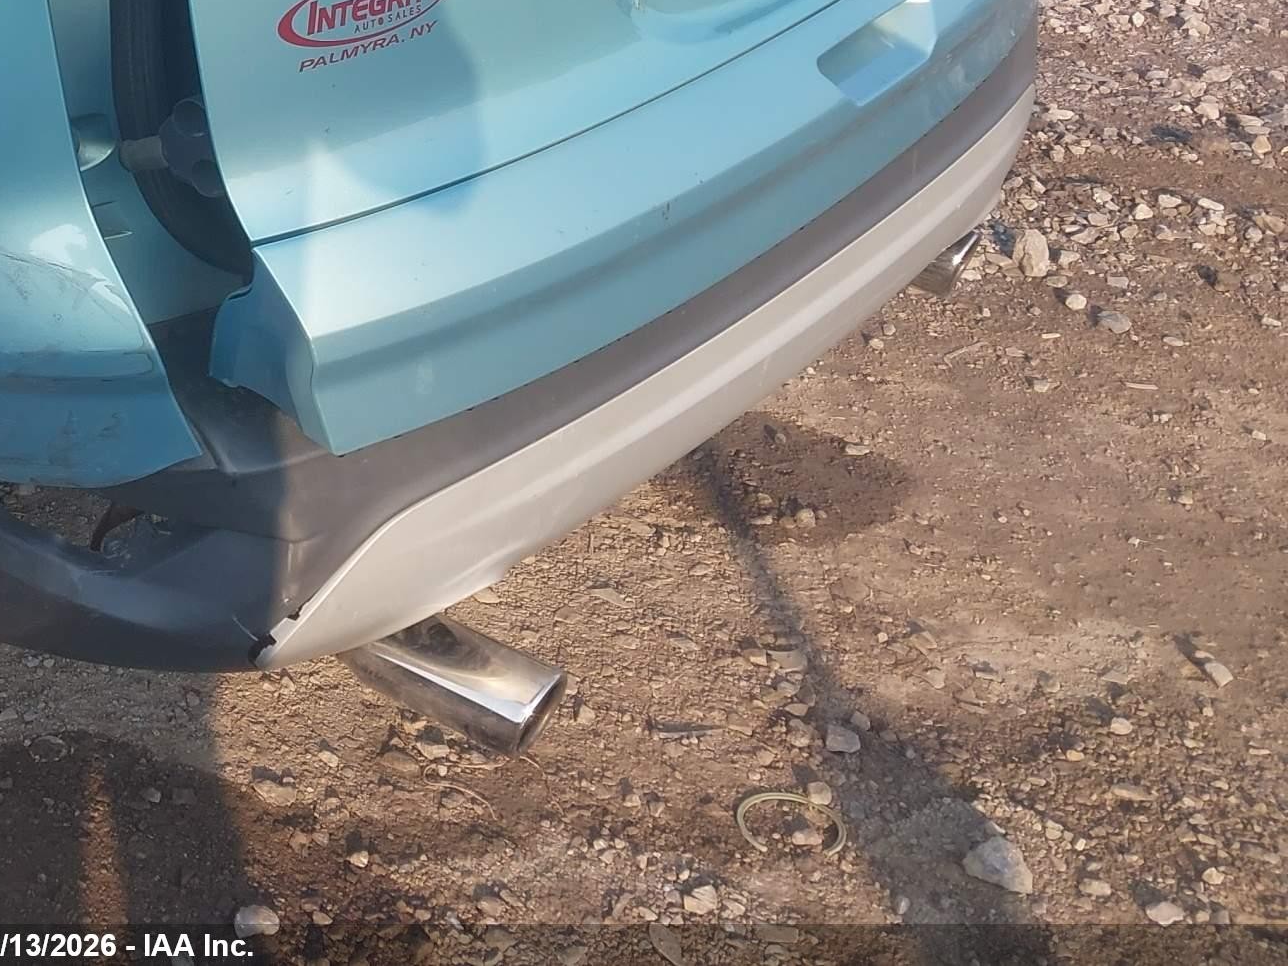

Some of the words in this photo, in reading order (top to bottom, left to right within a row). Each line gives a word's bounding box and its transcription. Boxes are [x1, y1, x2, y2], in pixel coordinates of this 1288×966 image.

[353, 16, 385, 34] AUTO
[386, 5, 422, 23] SALES
[409, 19, 440, 40] NY
